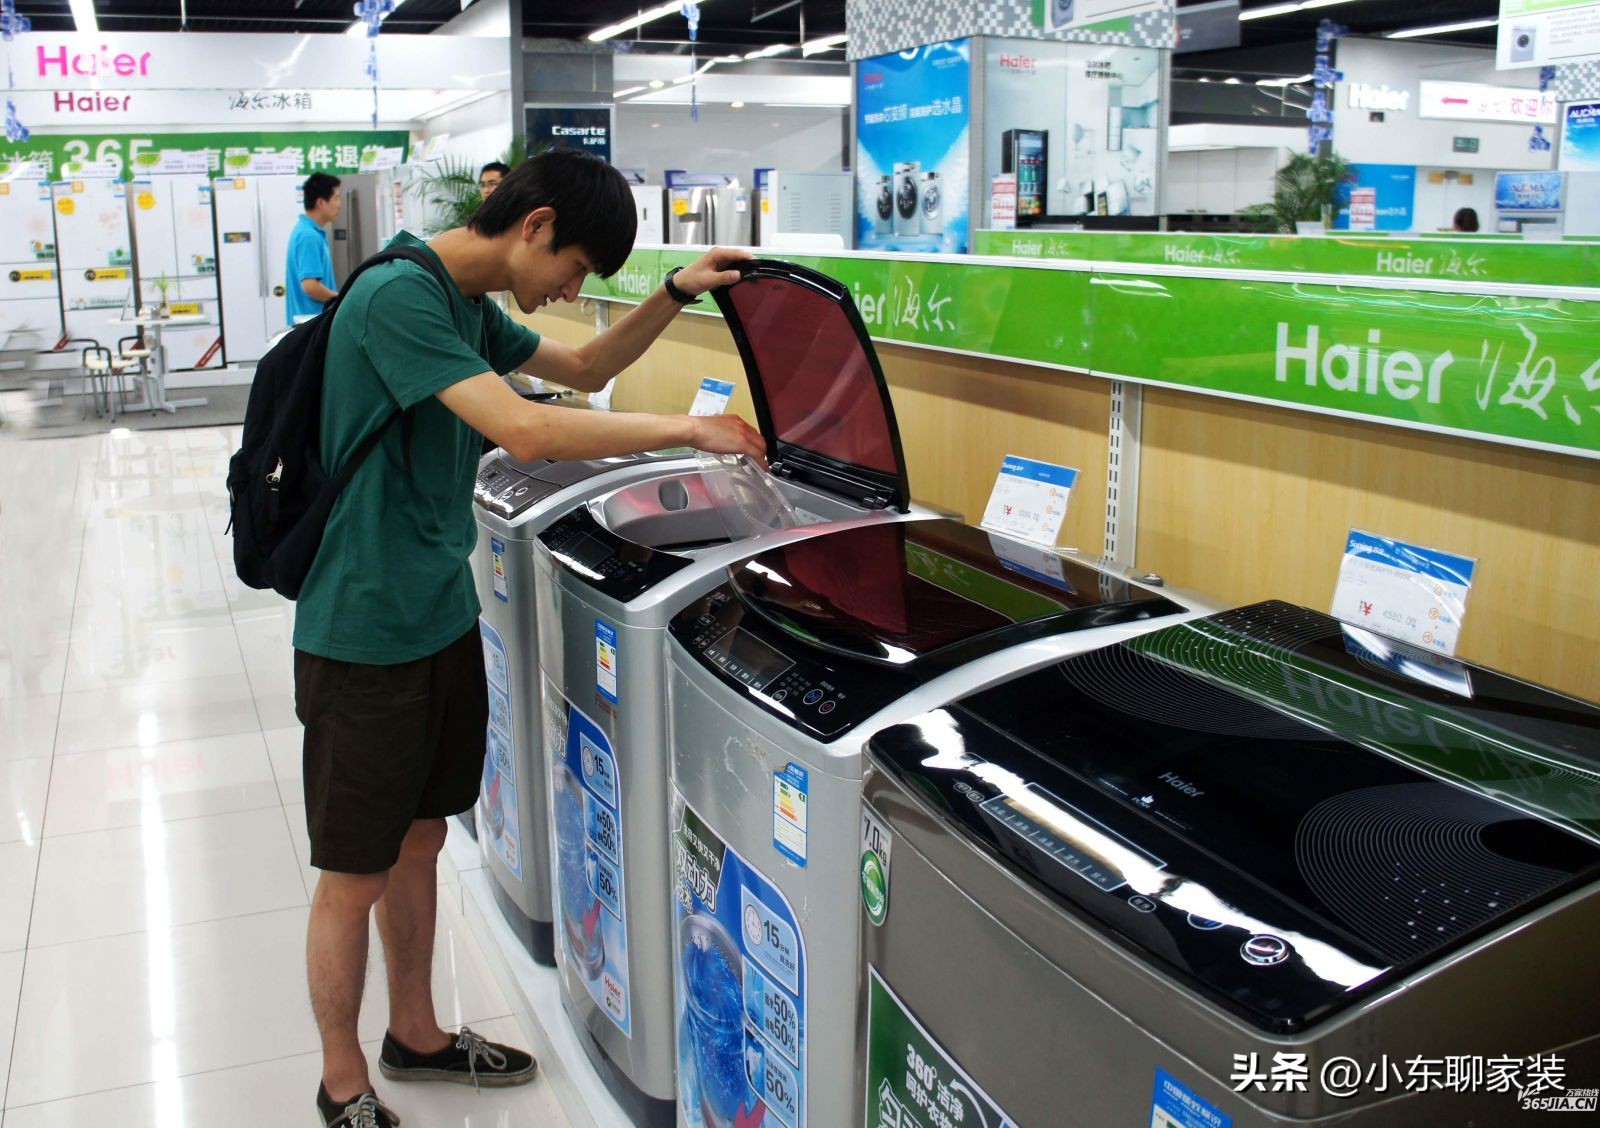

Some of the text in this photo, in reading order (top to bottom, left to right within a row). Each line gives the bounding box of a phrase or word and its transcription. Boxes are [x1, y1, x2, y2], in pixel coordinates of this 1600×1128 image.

[37, 45, 152, 77] Haier
[999, 54, 1036, 69] Haier
[54, 91, 132, 112] Haier
[552, 126, 606, 136] Casarte
[1012, 240, 1042, 256] Haier
[1164, 245, 1202, 263] Haier
[1377, 248, 1433, 274] Haier
[1275, 321, 1455, 404] Haier
[1349, 540, 1373, 554] Suning
[1158, 771, 1205, 797] Haier
[599, 873, 618, 902] 50%
[763, 919, 780, 949] 15
[765, 1068, 795, 1114] 50%
[937, 1079, 964, 1122] 洁净
